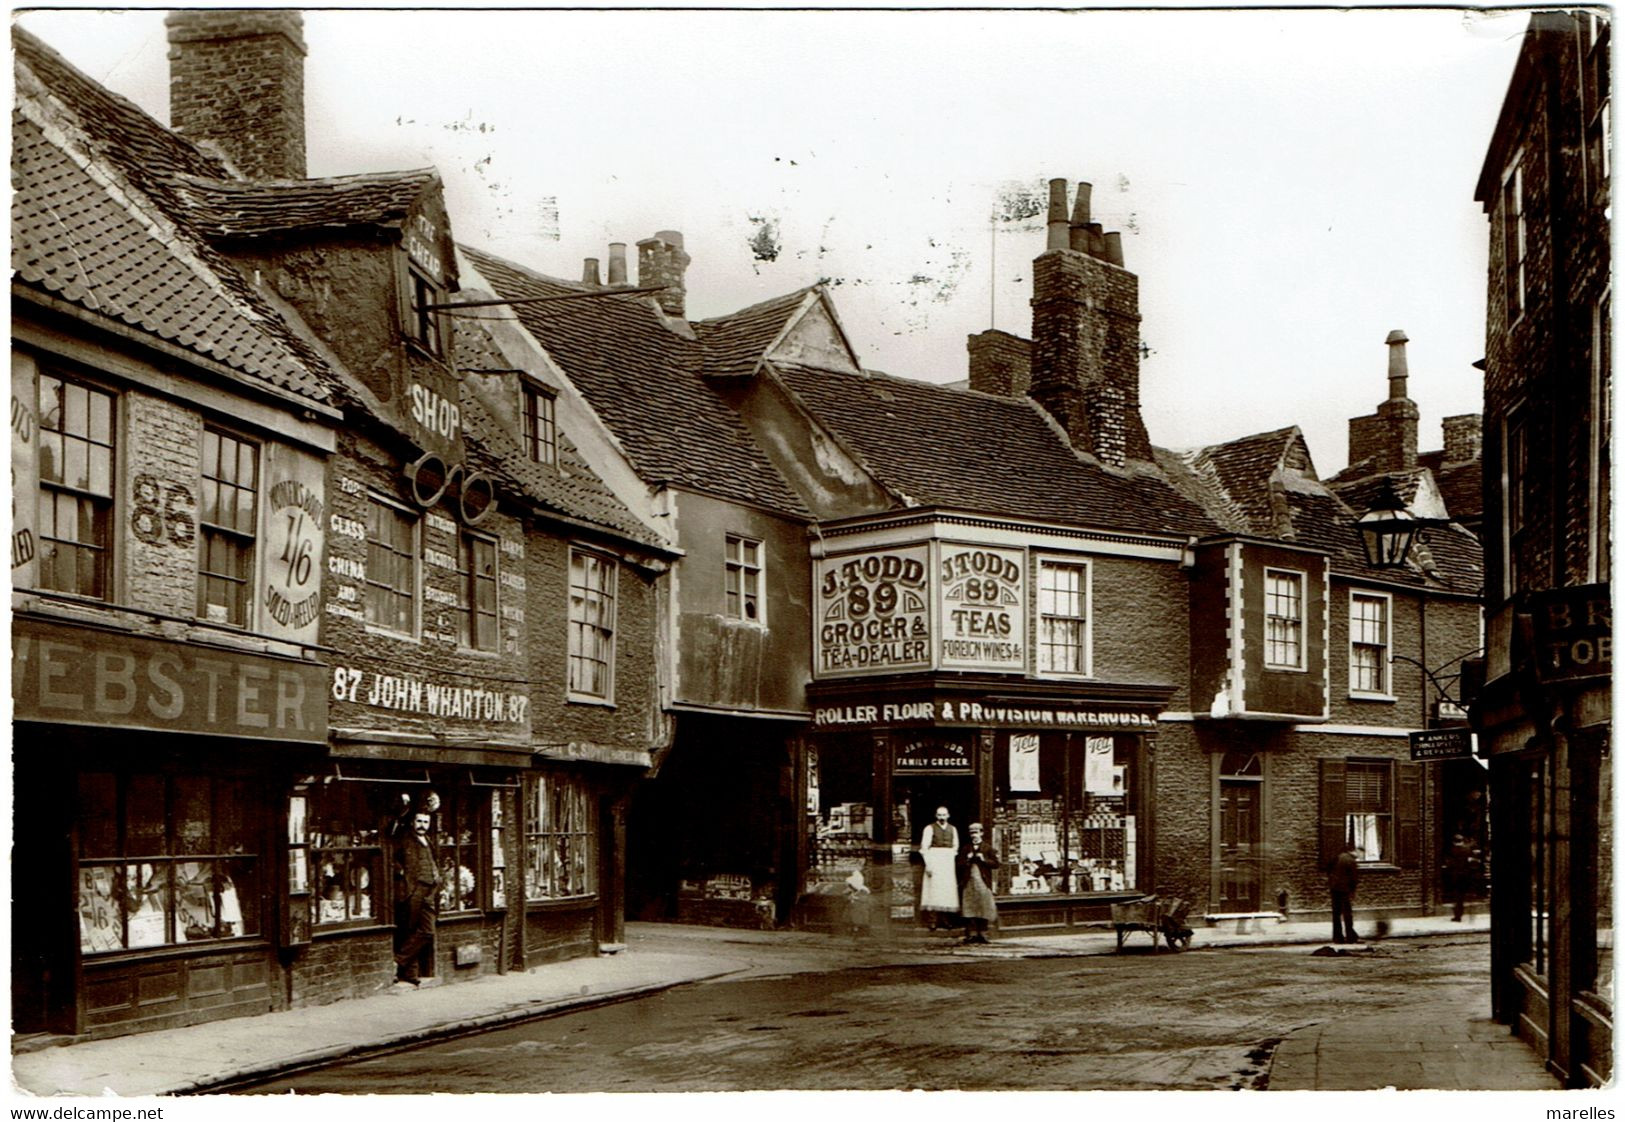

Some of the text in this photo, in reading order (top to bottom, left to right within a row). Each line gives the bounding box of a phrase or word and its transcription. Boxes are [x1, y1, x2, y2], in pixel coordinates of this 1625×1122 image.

[418, 214, 435, 242] THE
[409, 236, 441, 278] CHEAP
[412, 383, 459, 441] SHOP
[132, 473, 196, 550] 86
[280, 513, 313, 587] 1/6
[328, 556, 366, 581] CHINA
[848, 582, 898, 619] 89
[965, 578, 999, 605] 89
[822, 616, 927, 647] GROCER &
[952, 610, 1011, 638] TEAS
[943, 639, 981, 659] FOREIGN
[982, 641, 1012, 661] WINES
[332, 666, 362, 702] 87
[368, 673, 422, 713] JOHN
[509, 694, 530, 724] 87
[815, 705, 878, 726] ROLLER
[883, 702, 935, 722] FLOUR
[941, 702, 954, 718] &
[959, 702, 1052, 724] PROVISION
[897, 758, 928, 766] FAMILY
